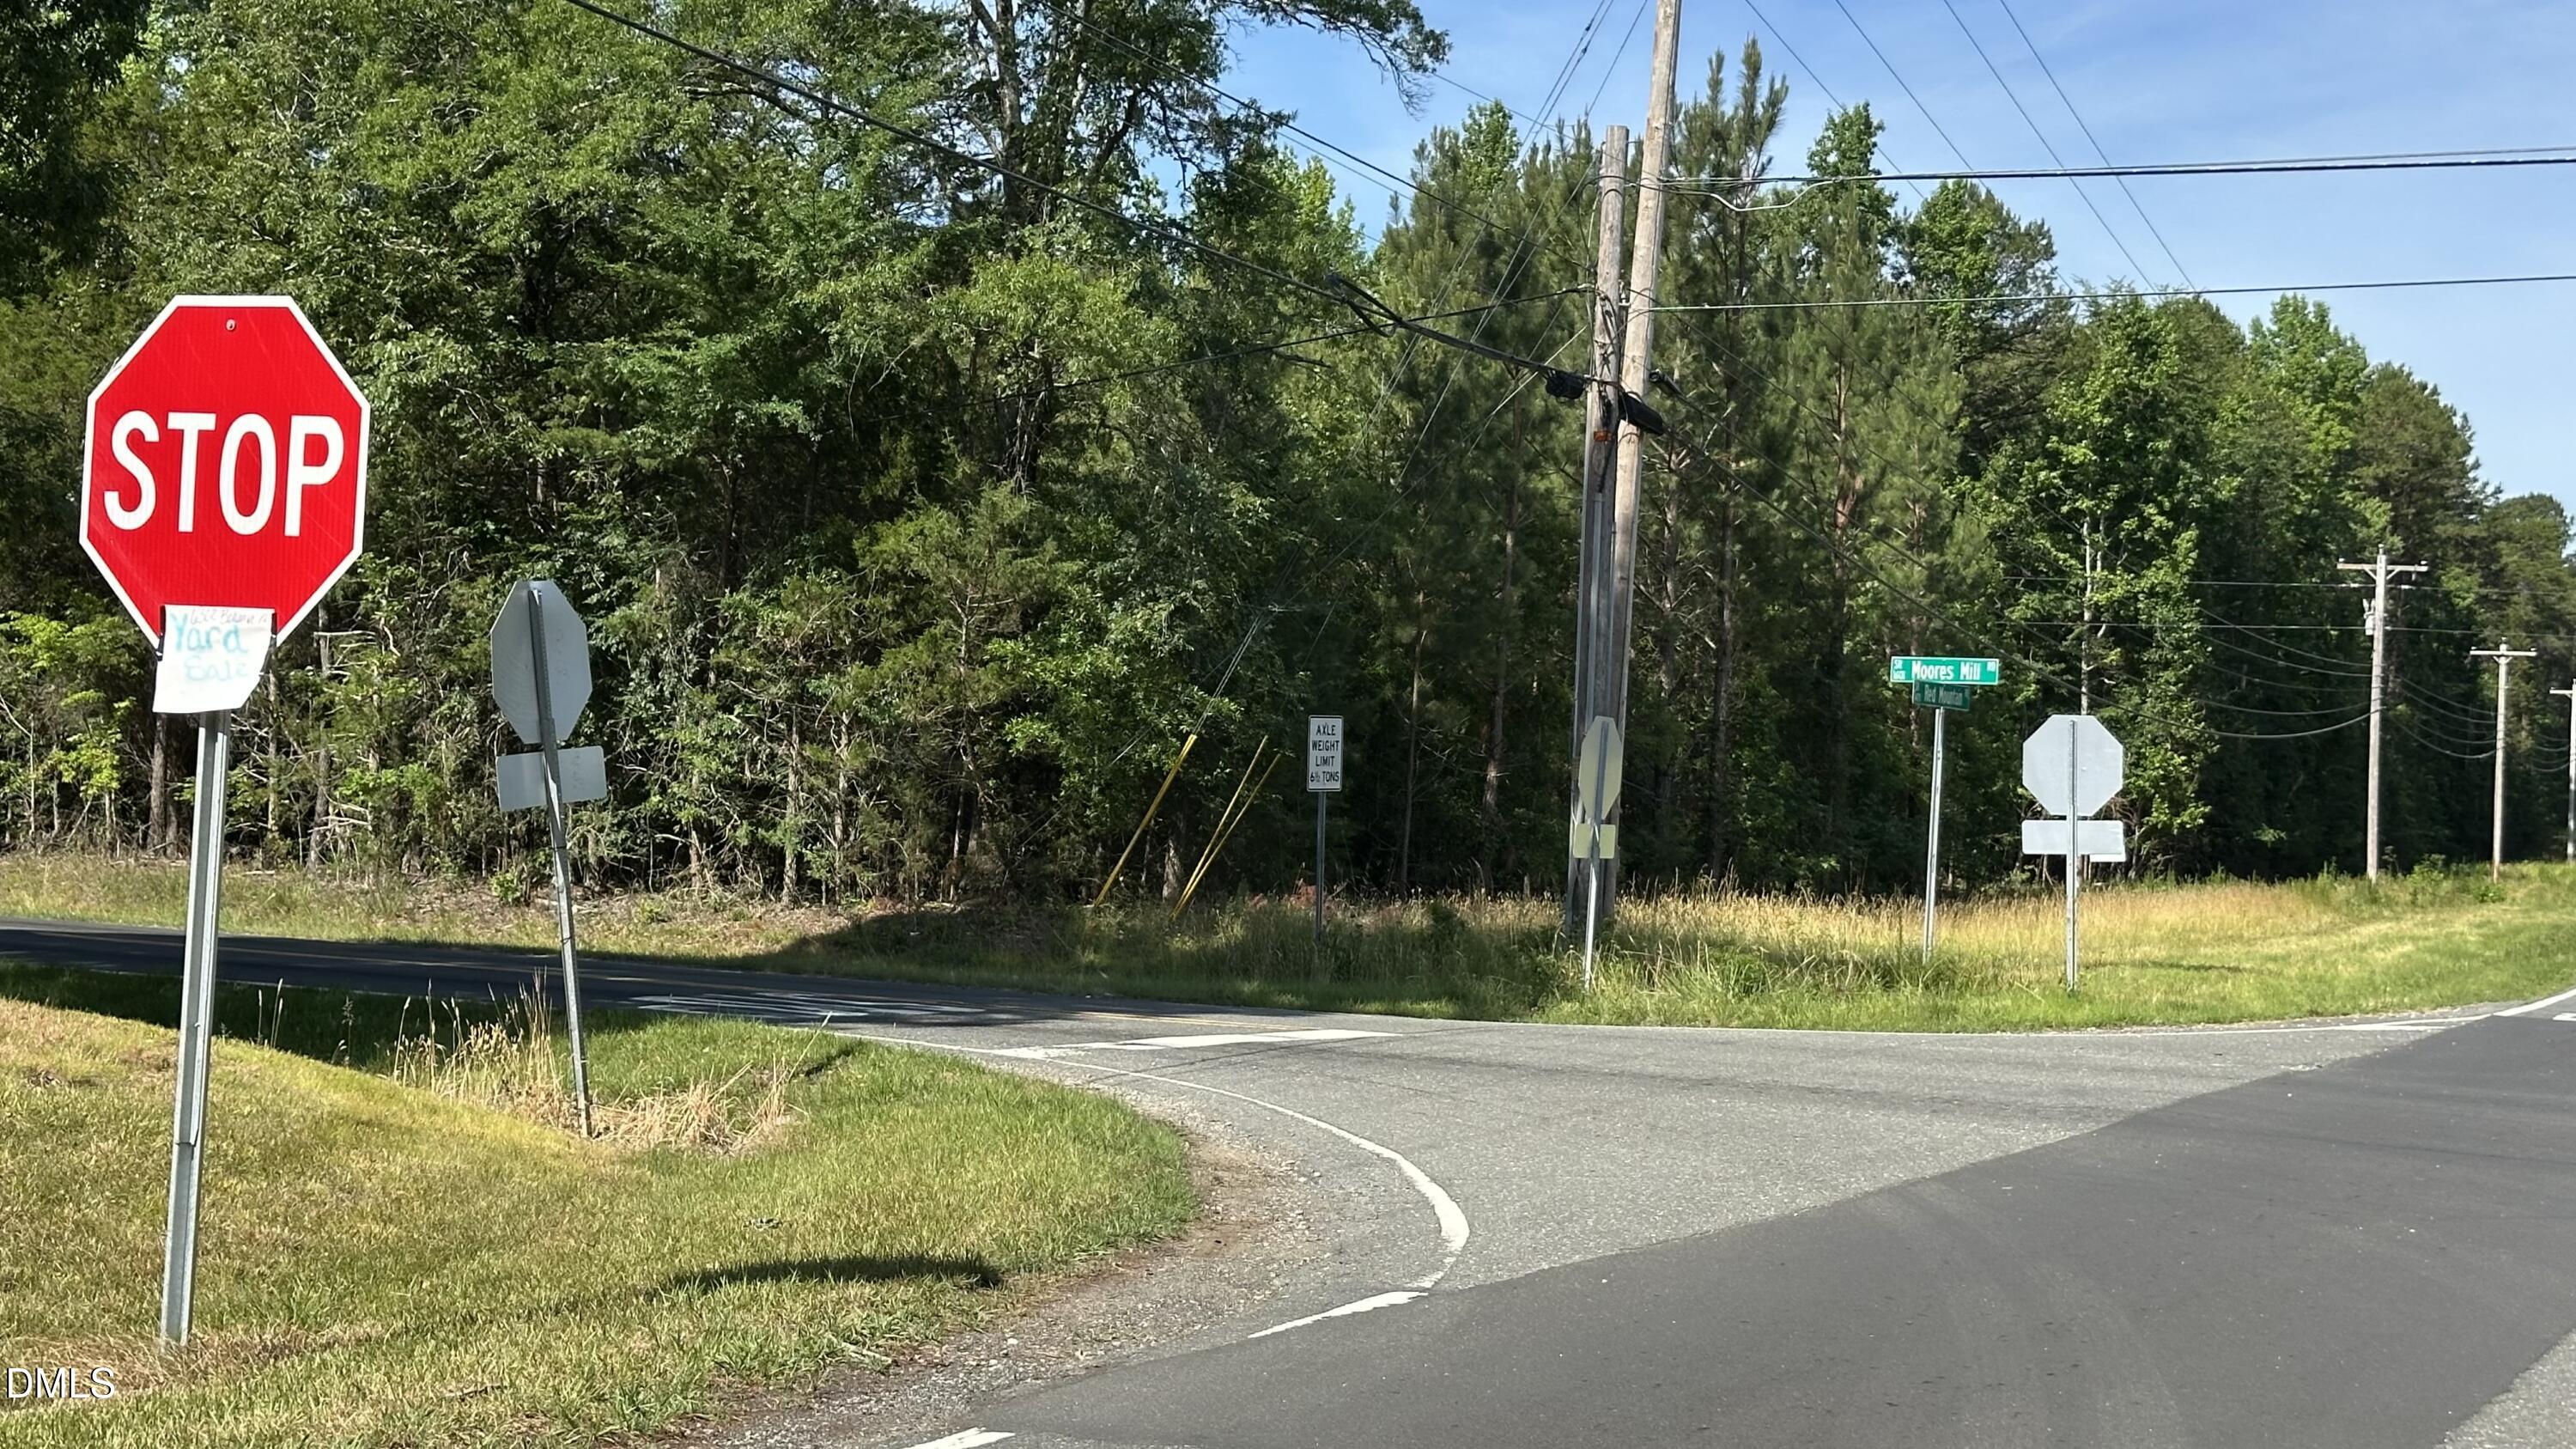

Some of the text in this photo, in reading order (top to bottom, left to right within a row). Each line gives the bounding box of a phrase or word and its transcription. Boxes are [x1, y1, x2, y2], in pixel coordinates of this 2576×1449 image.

[103, 410, 344, 537] STOP
[170, 612, 249, 654] Yard
[1911, 660, 1954, 680] Moores
[1959, 661, 1981, 680] Mill
[1924, 684, 1936, 703] Red
[1315, 724, 1336, 736] AXLE
[1311, 740, 1340, 752] WEIGHT
[1315, 756, 1335, 767] LIMIT
[1322, 771, 1340, 782] TONS
